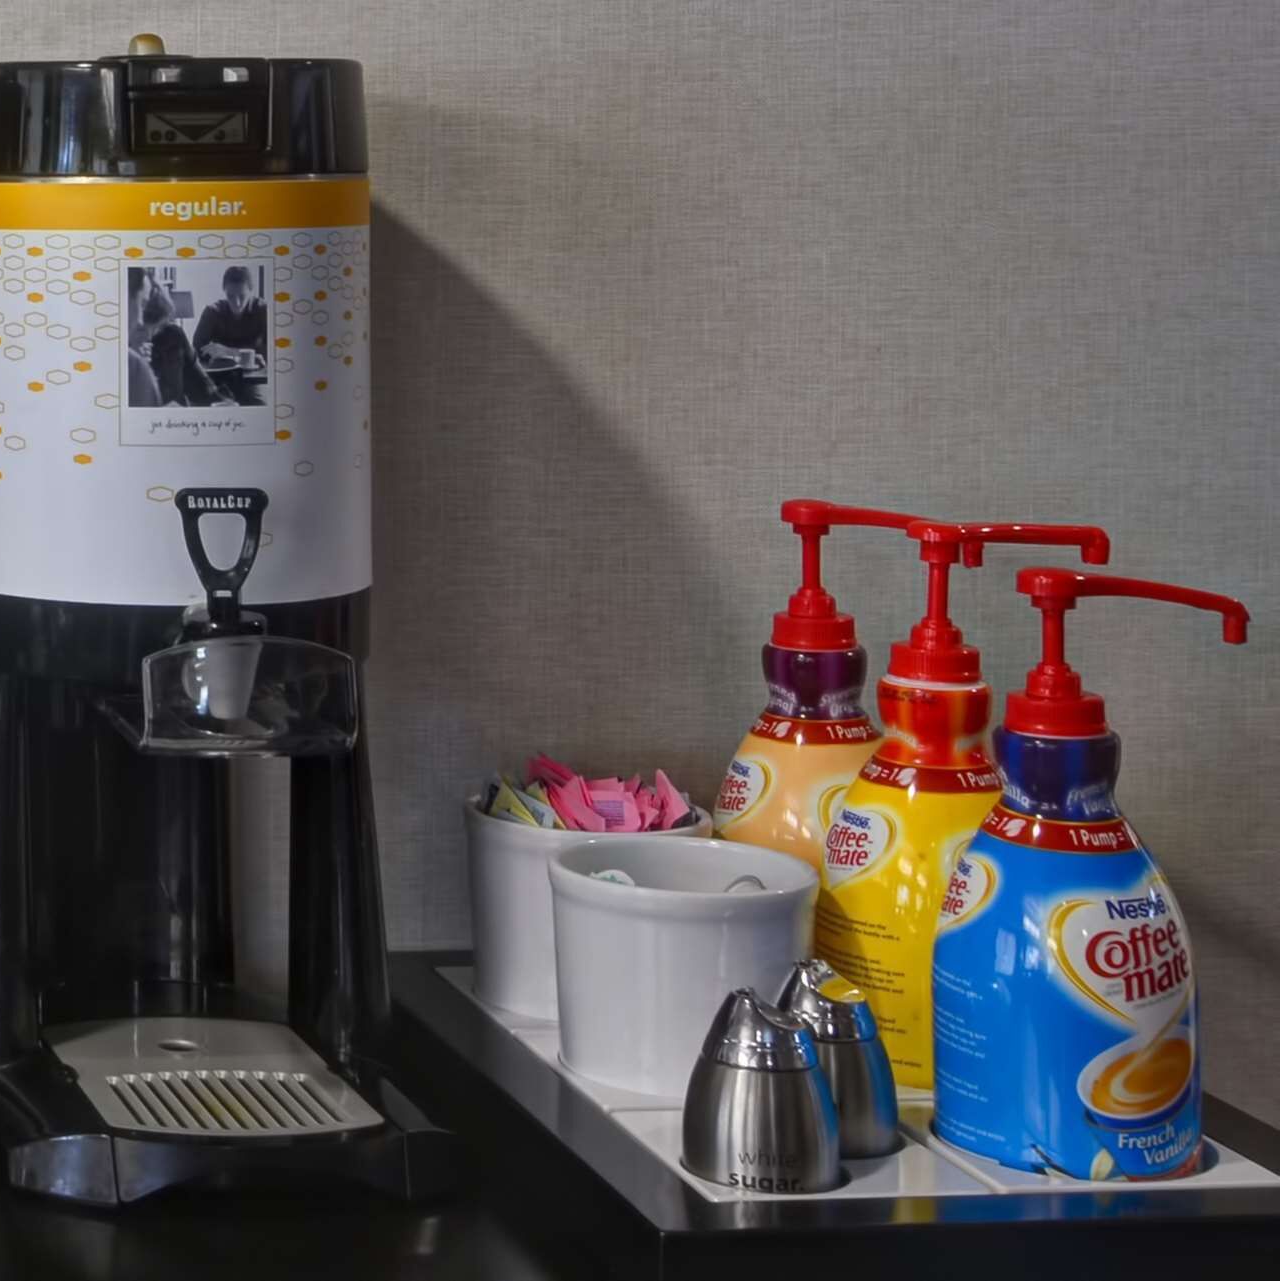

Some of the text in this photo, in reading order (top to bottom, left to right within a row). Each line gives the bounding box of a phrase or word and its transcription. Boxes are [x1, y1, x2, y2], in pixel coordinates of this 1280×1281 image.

[149, 195, 247, 221] regular.
[1123, 948, 1189, 1003] mate
[1118, 1122, 1175, 1150] French
